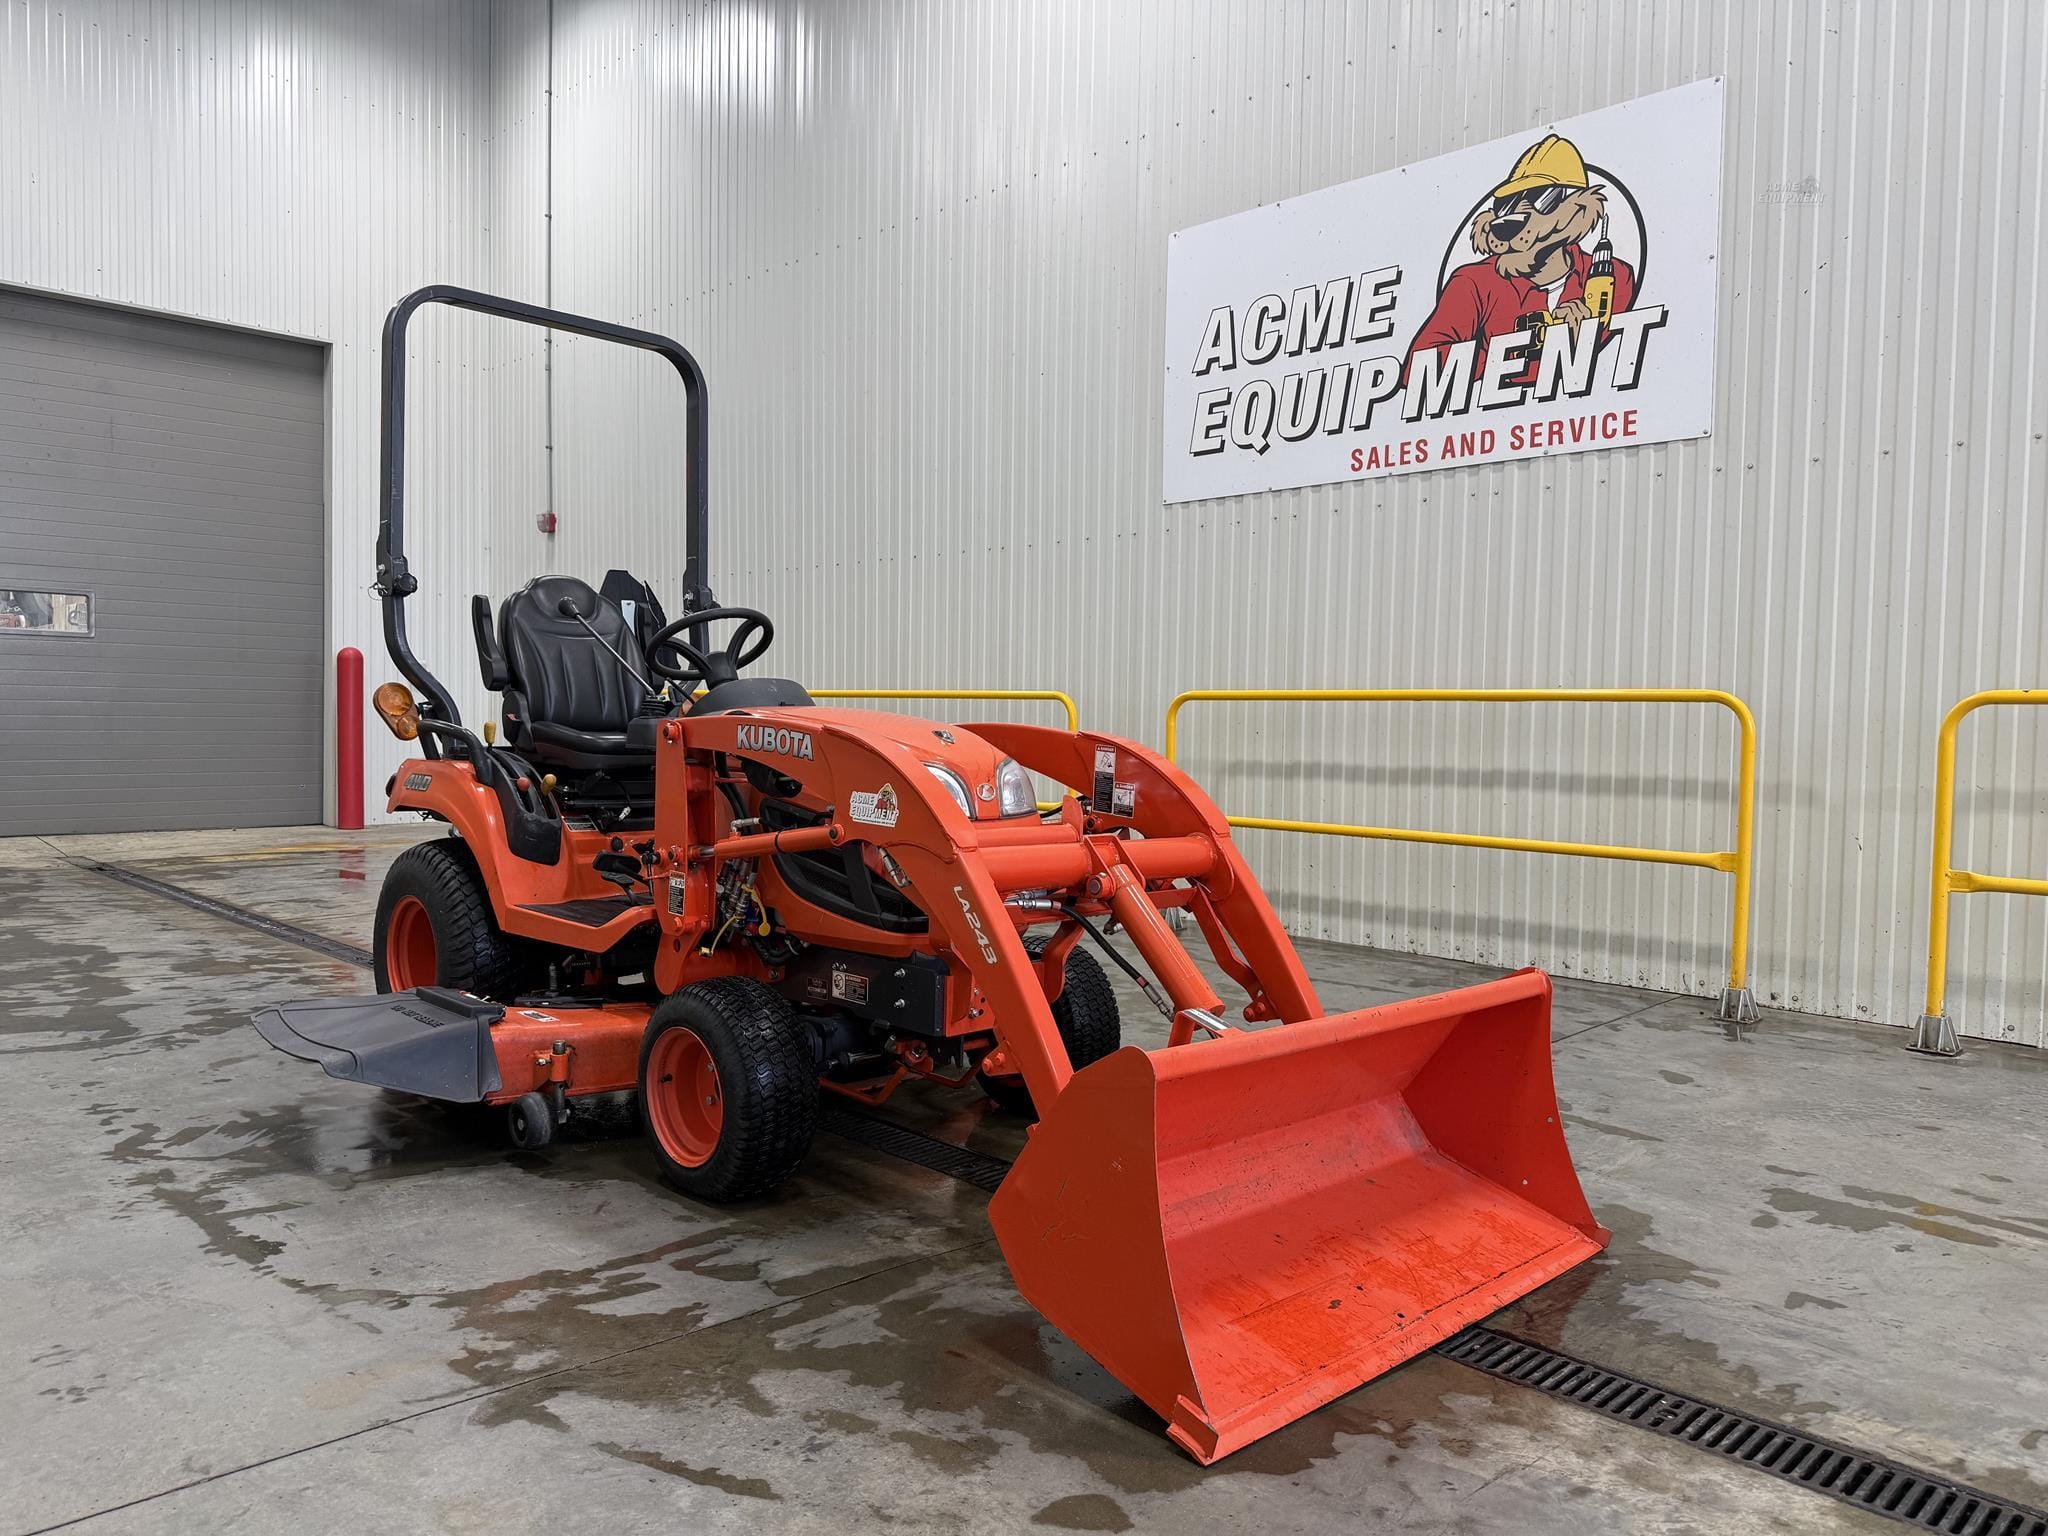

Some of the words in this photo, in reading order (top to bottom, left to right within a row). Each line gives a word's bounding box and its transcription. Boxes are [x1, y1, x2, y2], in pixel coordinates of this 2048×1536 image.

[1192, 265, 1403, 377] ACME
[1190, 304, 1669, 456] EQUIPMENT
[1350, 438, 1429, 472] SALES
[1441, 429, 1496, 460] AND
[1510, 409, 1638, 451] SERVICE
[737, 724, 815, 761] KUBOTA
[851, 804, 899, 822] EQUIPMENT
[953, 885, 998, 965] LA243
